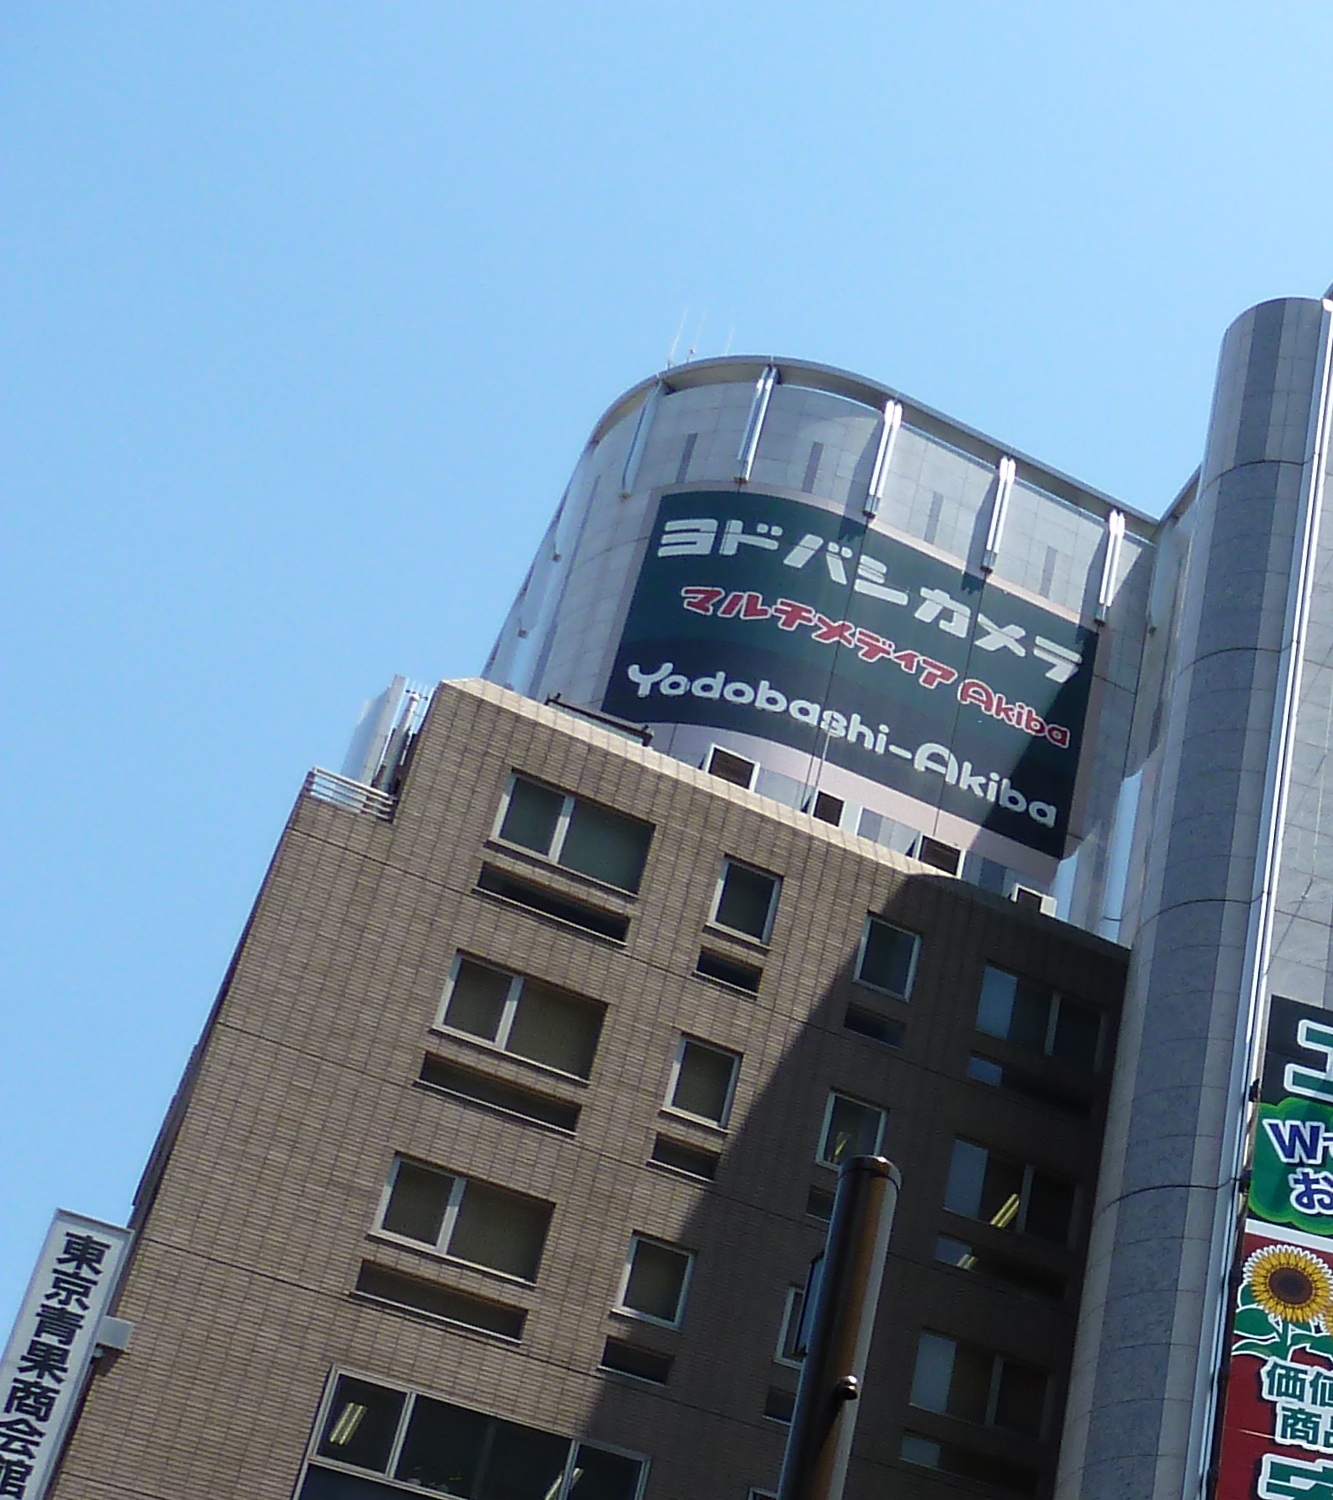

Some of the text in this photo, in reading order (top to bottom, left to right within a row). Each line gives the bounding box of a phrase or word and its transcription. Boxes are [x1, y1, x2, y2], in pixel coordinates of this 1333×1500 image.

[658, 518, 1083, 684] ヨドバシカメラ
[681, 586, 1070, 749] マルチメディア Akiba
[627, 662, 1058, 829] Yodobashi-Akiba
